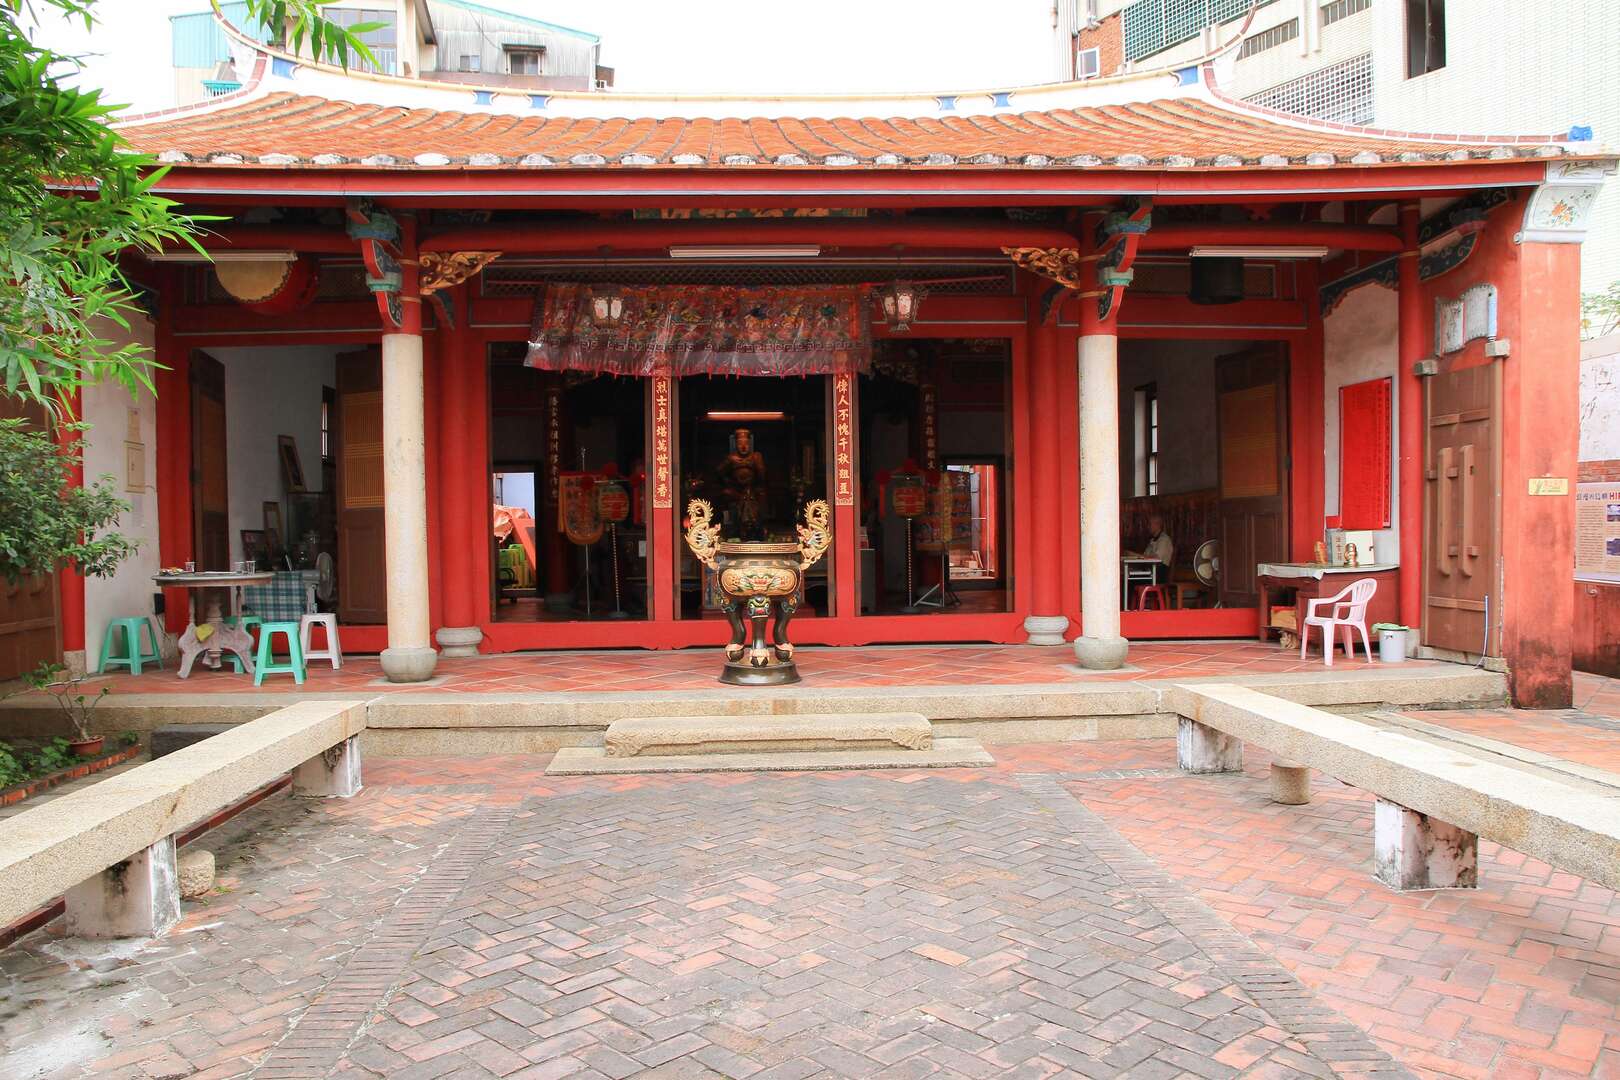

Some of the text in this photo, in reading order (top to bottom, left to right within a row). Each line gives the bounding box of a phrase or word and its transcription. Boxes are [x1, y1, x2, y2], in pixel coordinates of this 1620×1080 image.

[656, 374, 668, 497] 烈士真堪萬世馨香
[836, 373, 850, 495] 偉人不愧千秋俎豆
